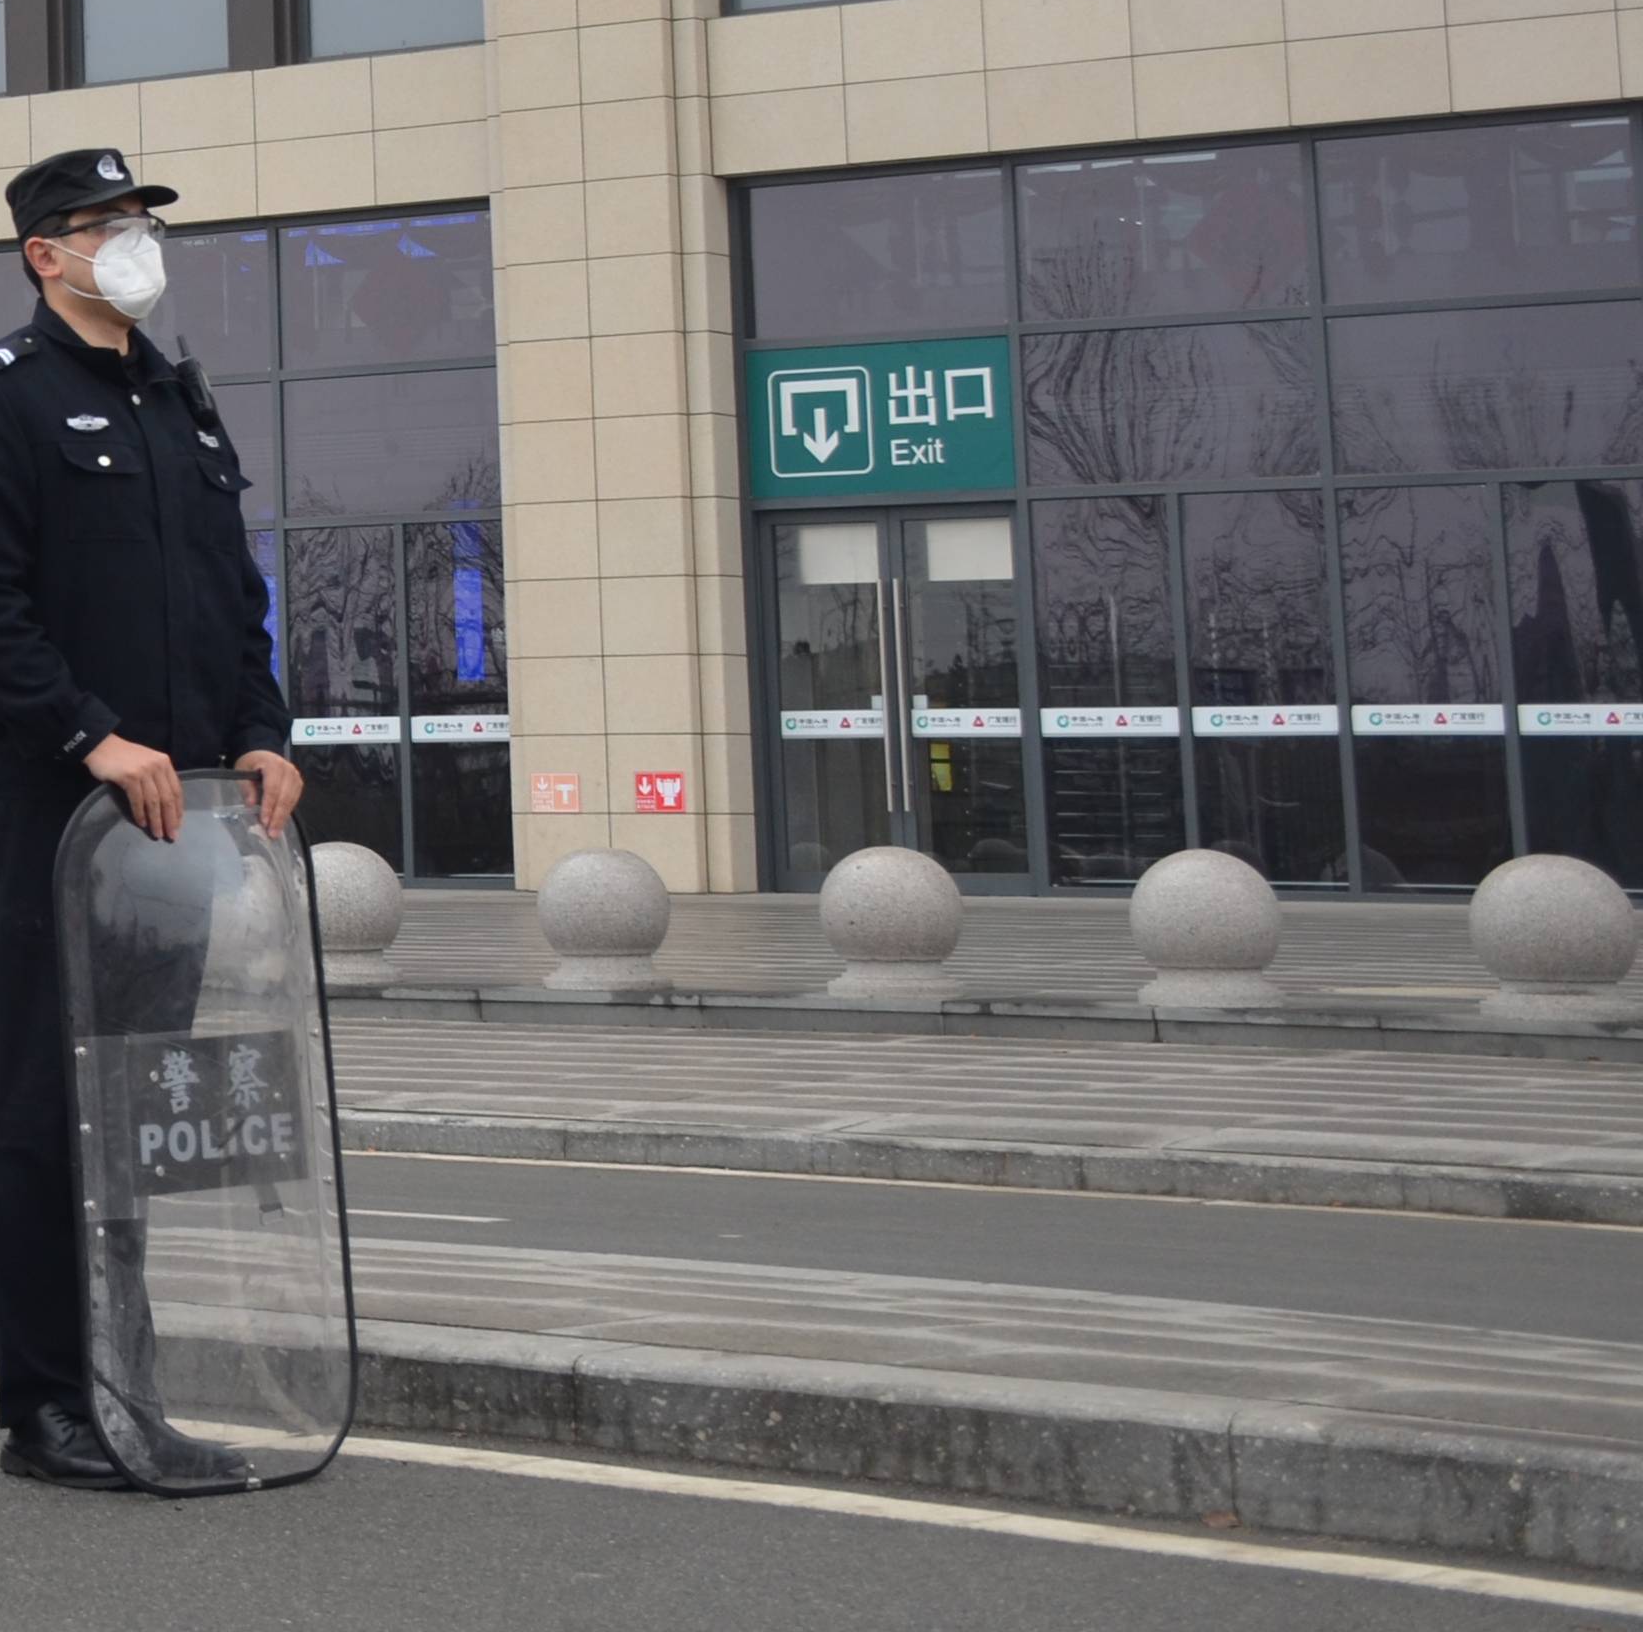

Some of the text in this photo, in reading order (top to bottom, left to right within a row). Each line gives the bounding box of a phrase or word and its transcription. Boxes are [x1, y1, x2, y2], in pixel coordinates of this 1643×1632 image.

[887, 366, 994, 426] 出口
[889, 438, 945, 466] Exit
[159, 1043, 270, 1114] 警察
[139, 1112, 292, 1166] POLICE
